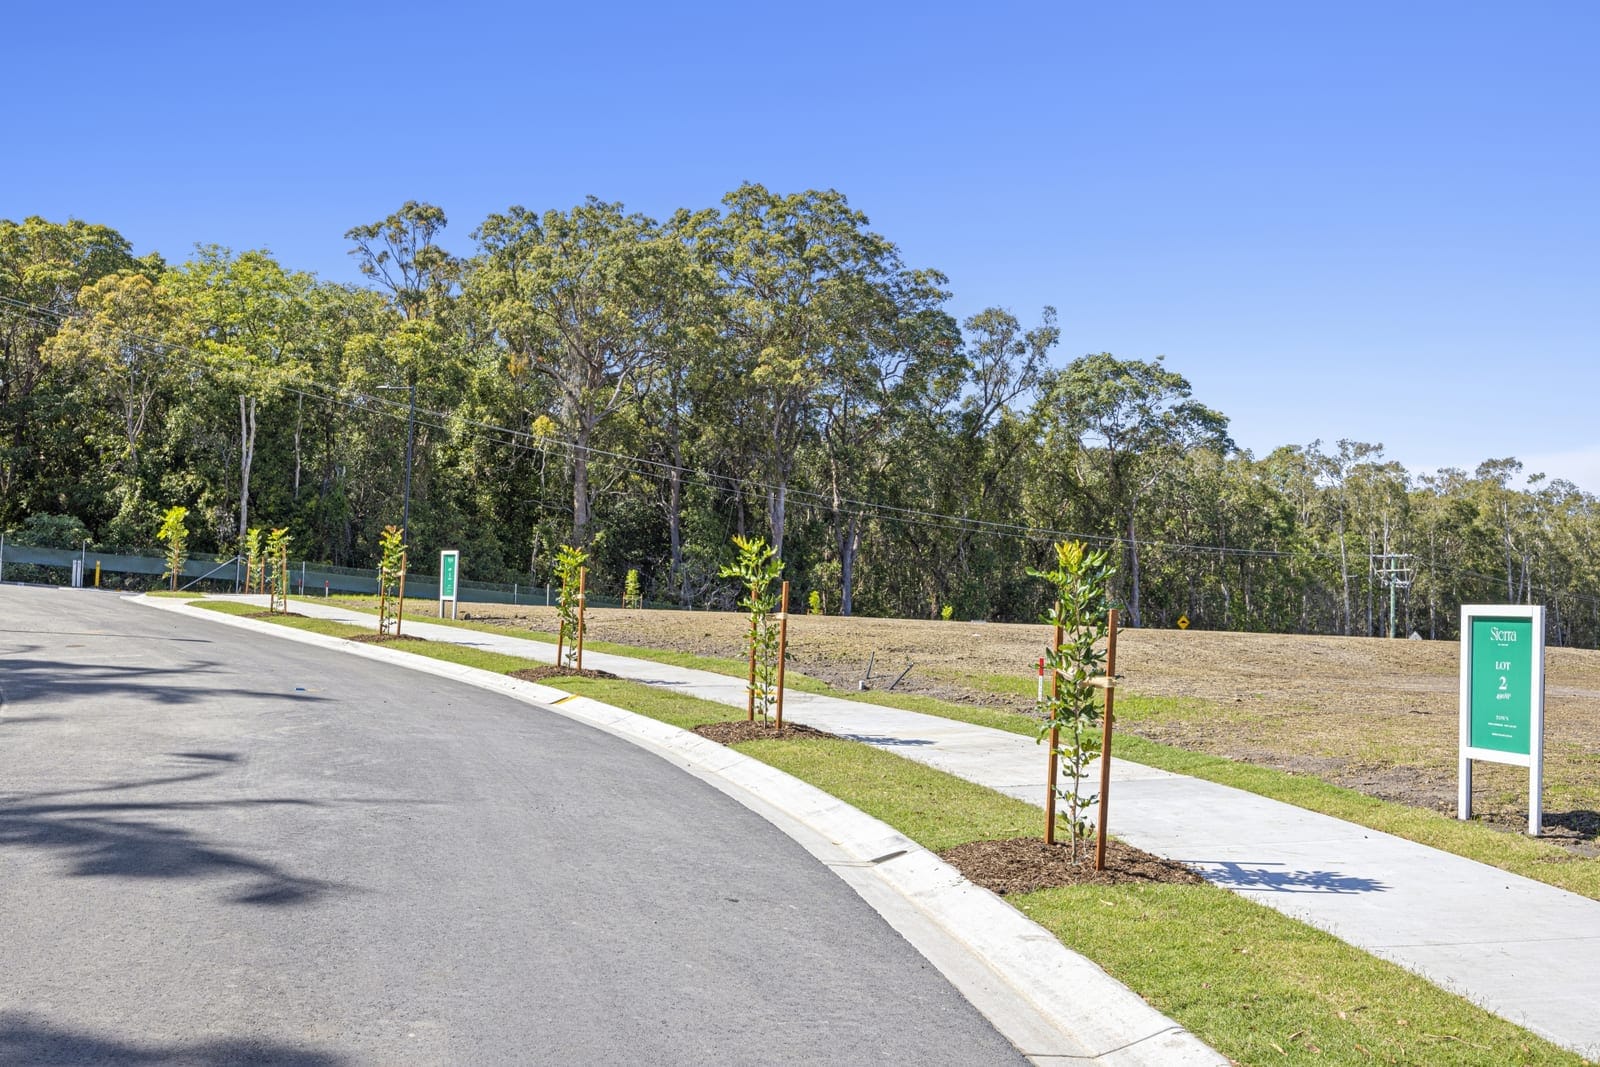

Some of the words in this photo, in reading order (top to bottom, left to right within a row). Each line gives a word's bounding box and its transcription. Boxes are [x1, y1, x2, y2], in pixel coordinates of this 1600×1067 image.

[1490, 626, 1517, 641] Sierra
[1495, 661, 1511, 670] LOT
[1499, 676, 1507, 690] 2
